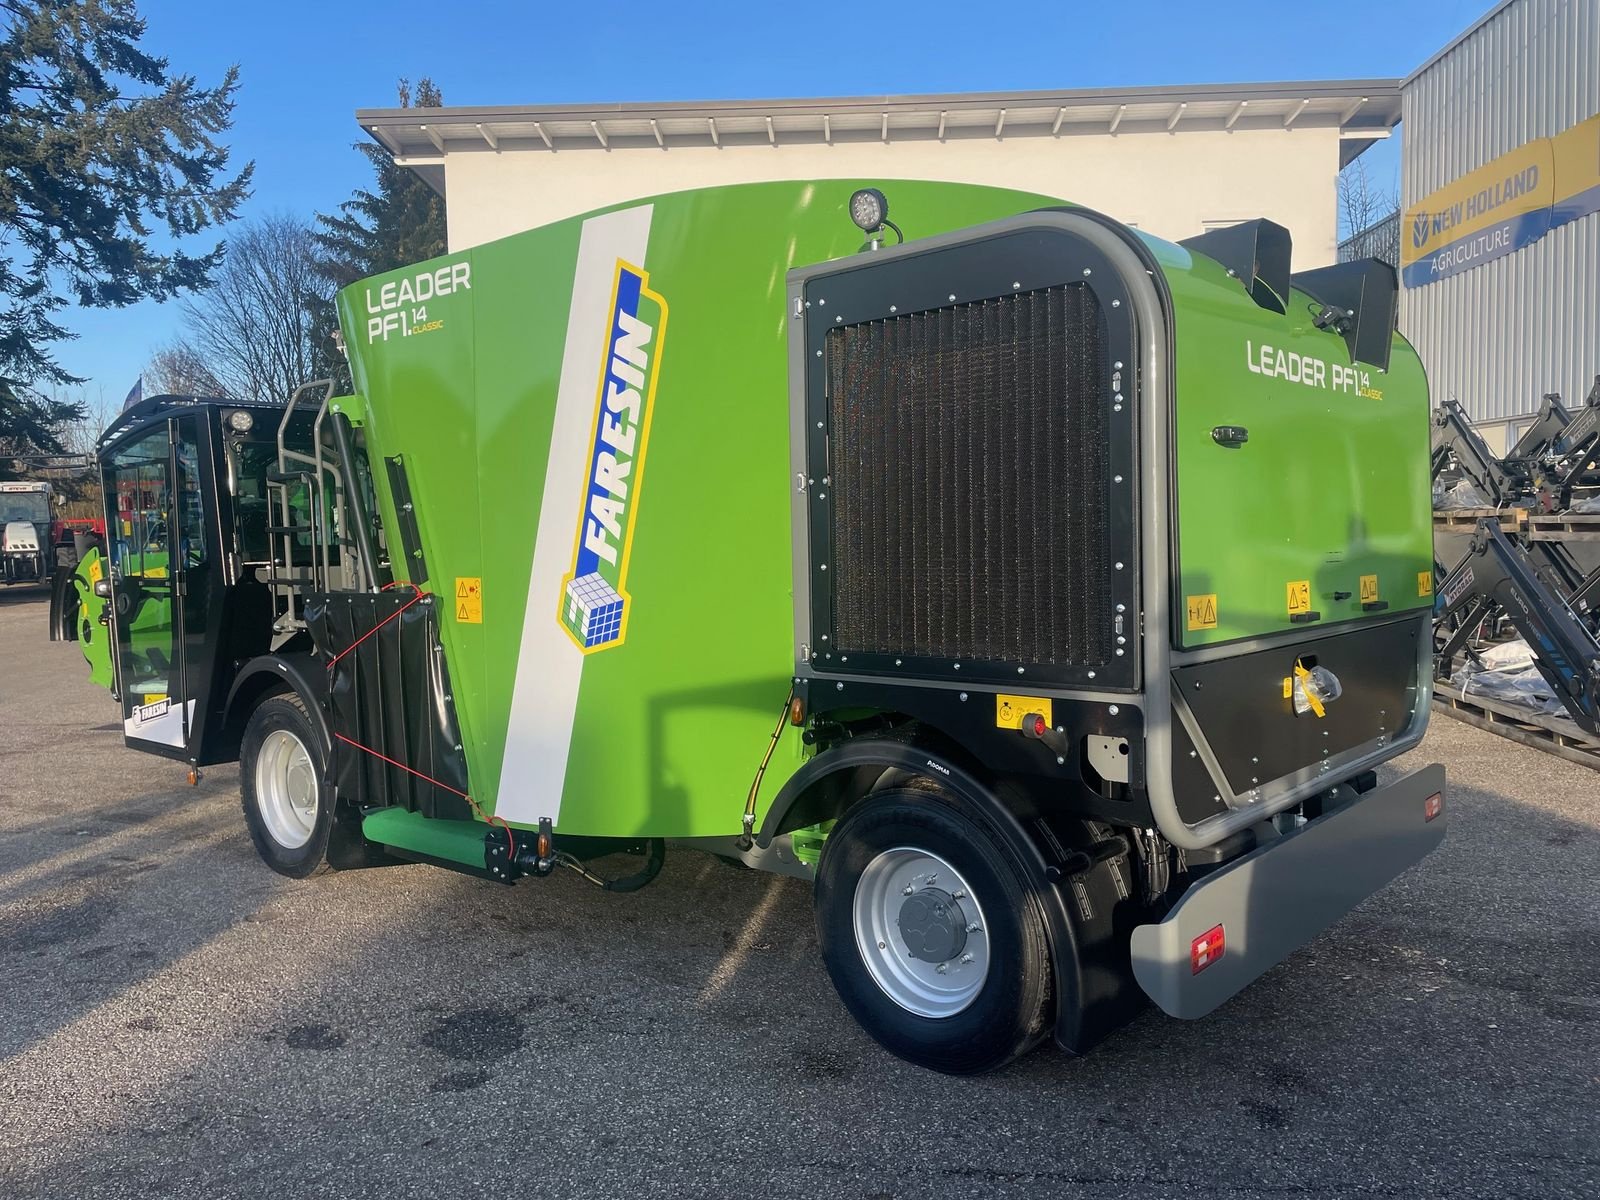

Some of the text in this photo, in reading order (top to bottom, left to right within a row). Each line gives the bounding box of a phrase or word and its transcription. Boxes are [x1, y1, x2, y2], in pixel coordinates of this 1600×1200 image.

[1432, 165, 1539, 236] NEW HOLLAND
[1430, 226, 1510, 274] AGRICULTURE
[366, 262, 471, 314] LEADER
[412, 320, 444, 334] CLASSIC
[1247, 340, 1326, 389] LEADER
[1361, 387, 1383, 400] CLASSIC
[584, 308, 653, 567] FARESIN
[1510, 587, 1529, 615] EURO
[141, 701, 168, 721] FARESIN
